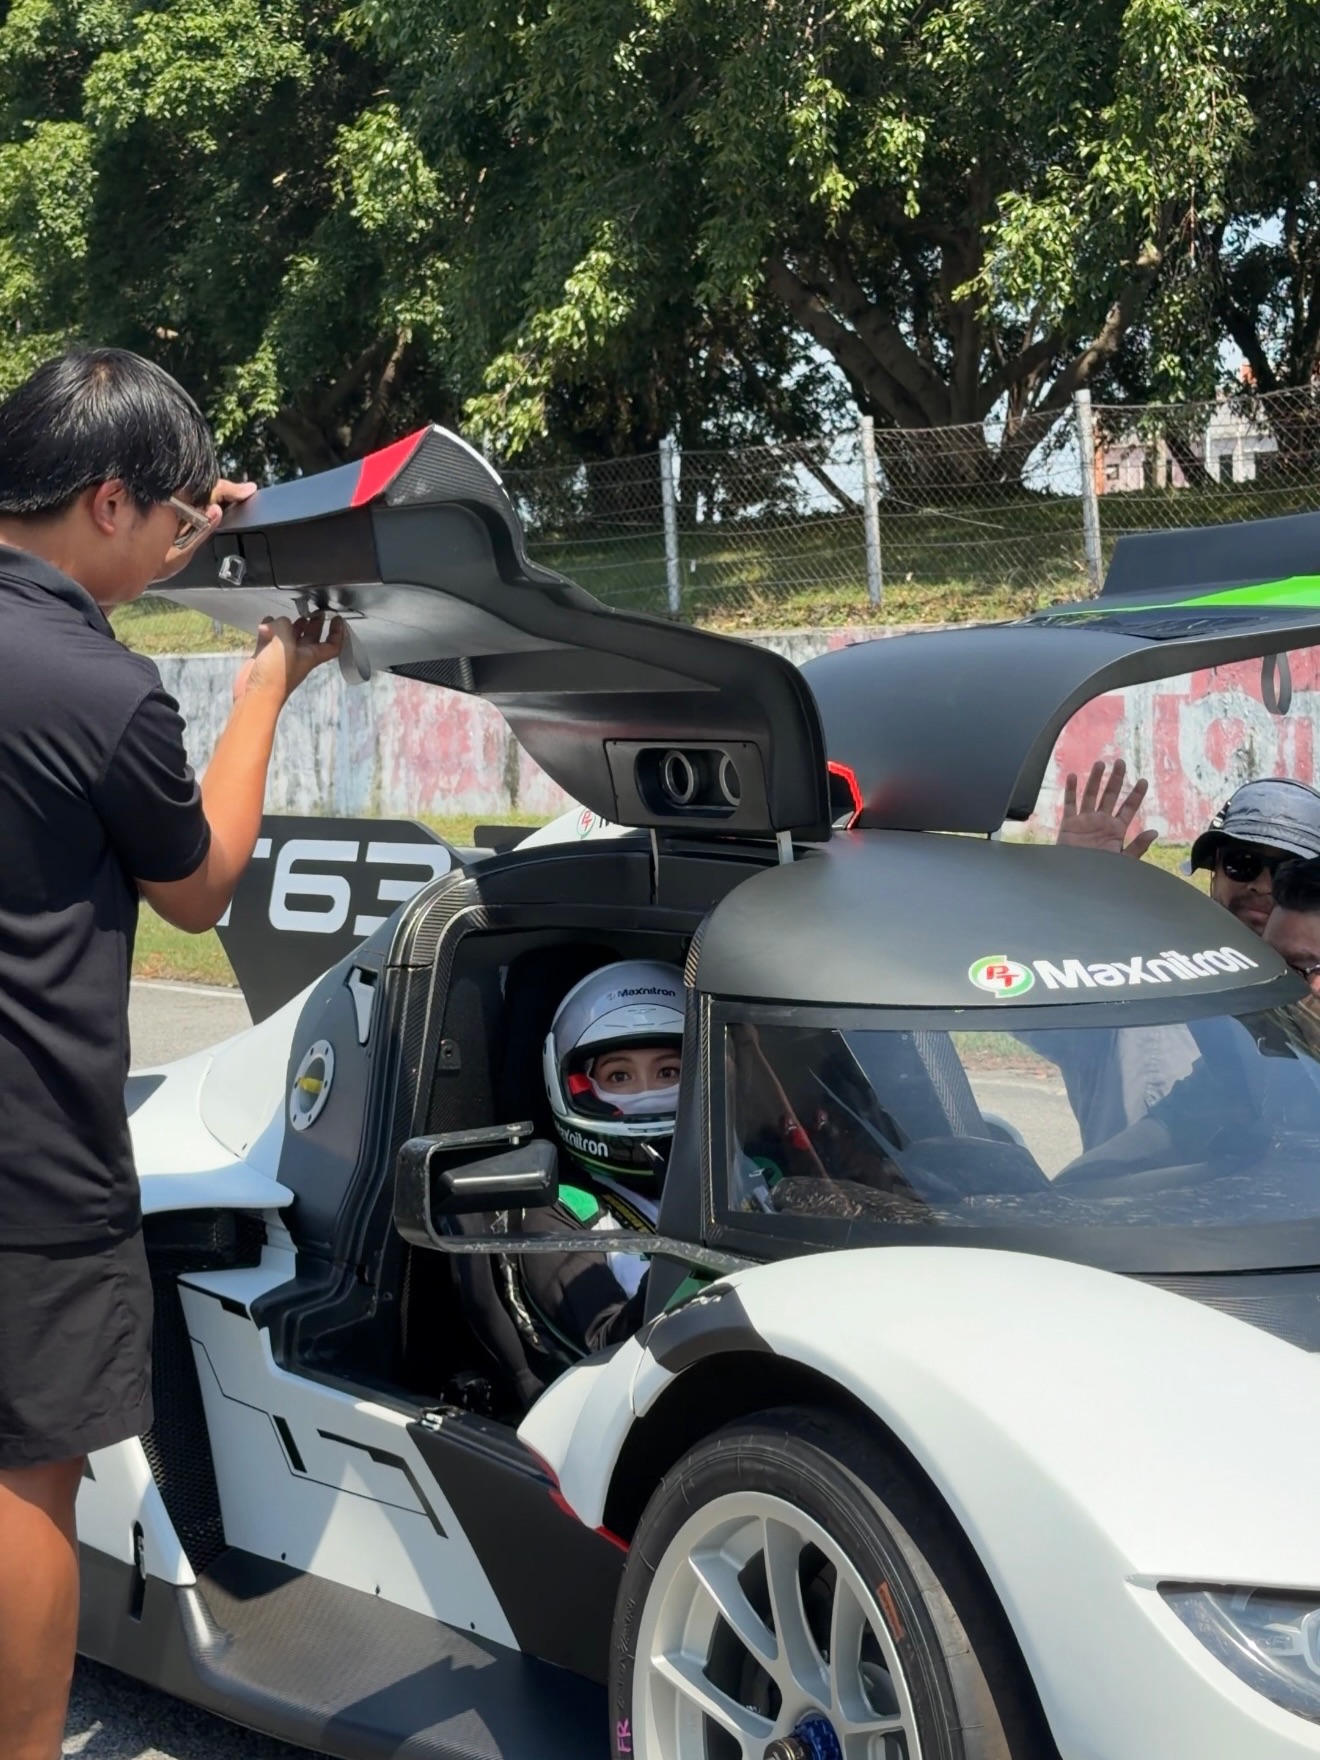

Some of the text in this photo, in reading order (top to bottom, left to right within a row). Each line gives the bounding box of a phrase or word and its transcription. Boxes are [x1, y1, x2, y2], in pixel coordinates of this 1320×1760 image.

[1032, 946, 1260, 990] Maxnitron
[617, 986, 676, 998] Maxnitron
[617, 1717, 632, 1753] FR
